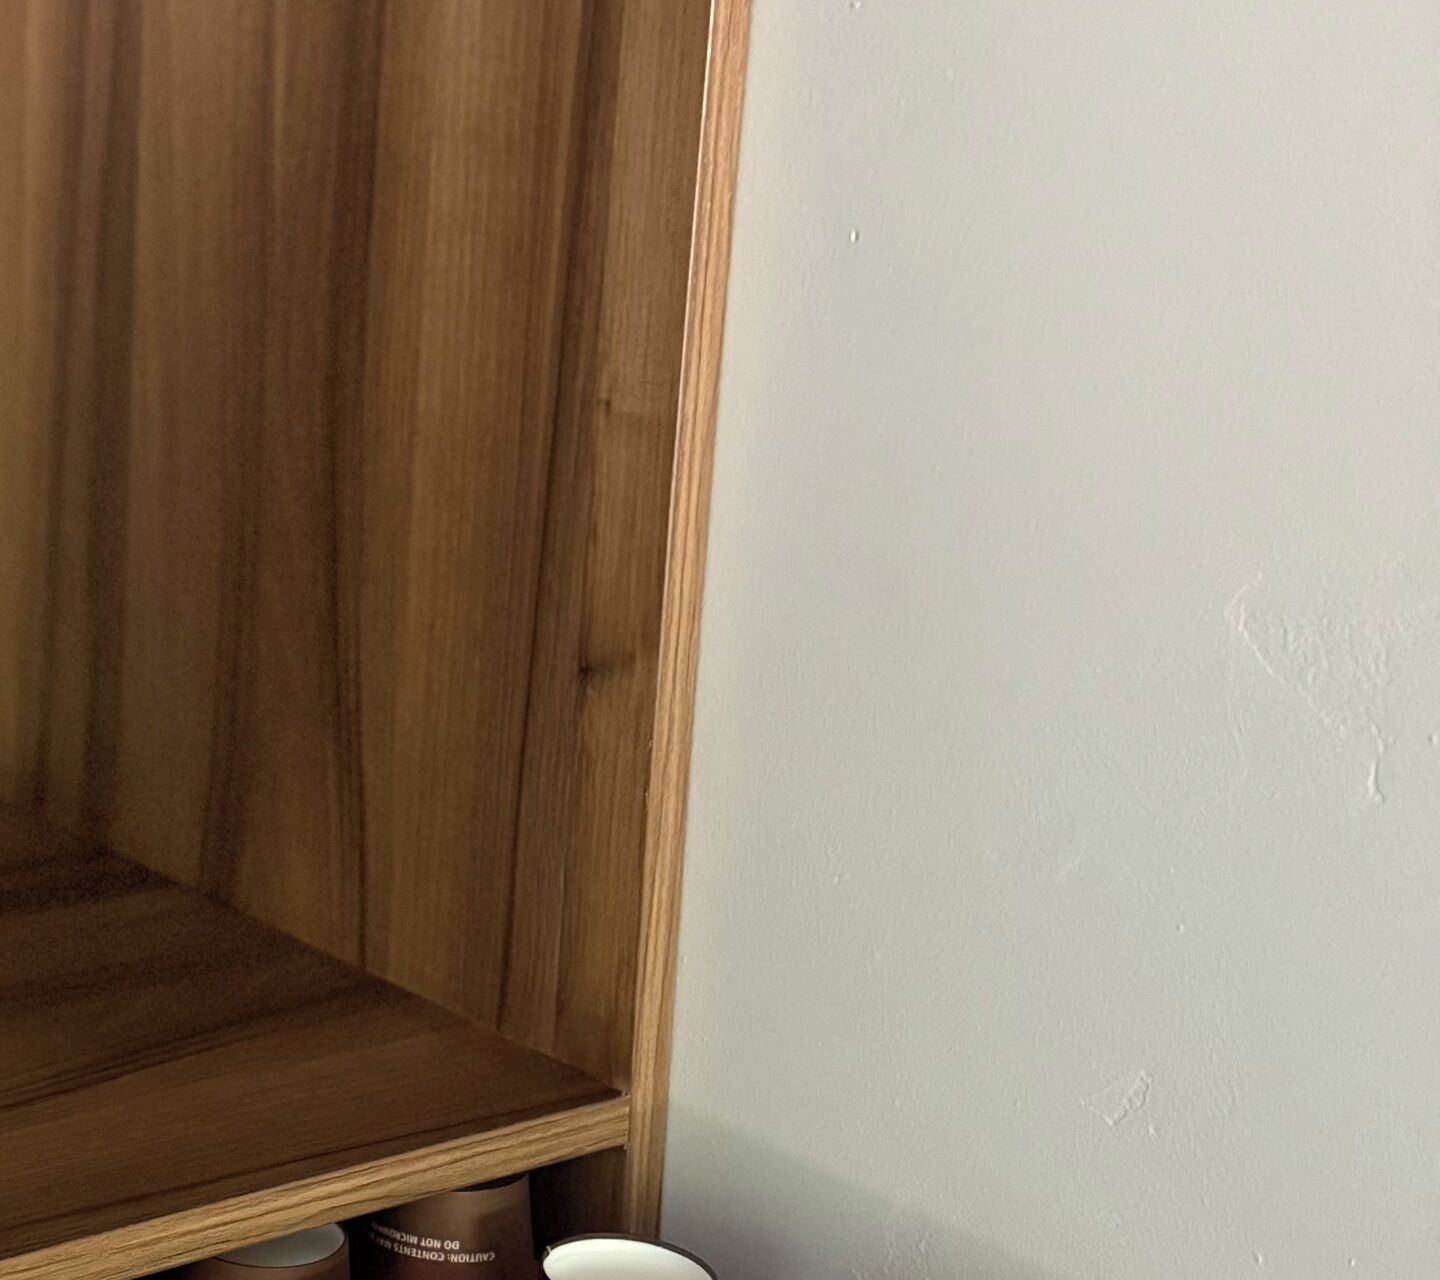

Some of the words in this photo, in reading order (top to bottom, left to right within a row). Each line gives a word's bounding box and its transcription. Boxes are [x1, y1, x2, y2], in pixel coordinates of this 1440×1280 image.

[420, 1237, 441, 1249] NOT
[443, 1240, 460, 1250] DO
[447, 1252, 496, 1263] CAUTION:
